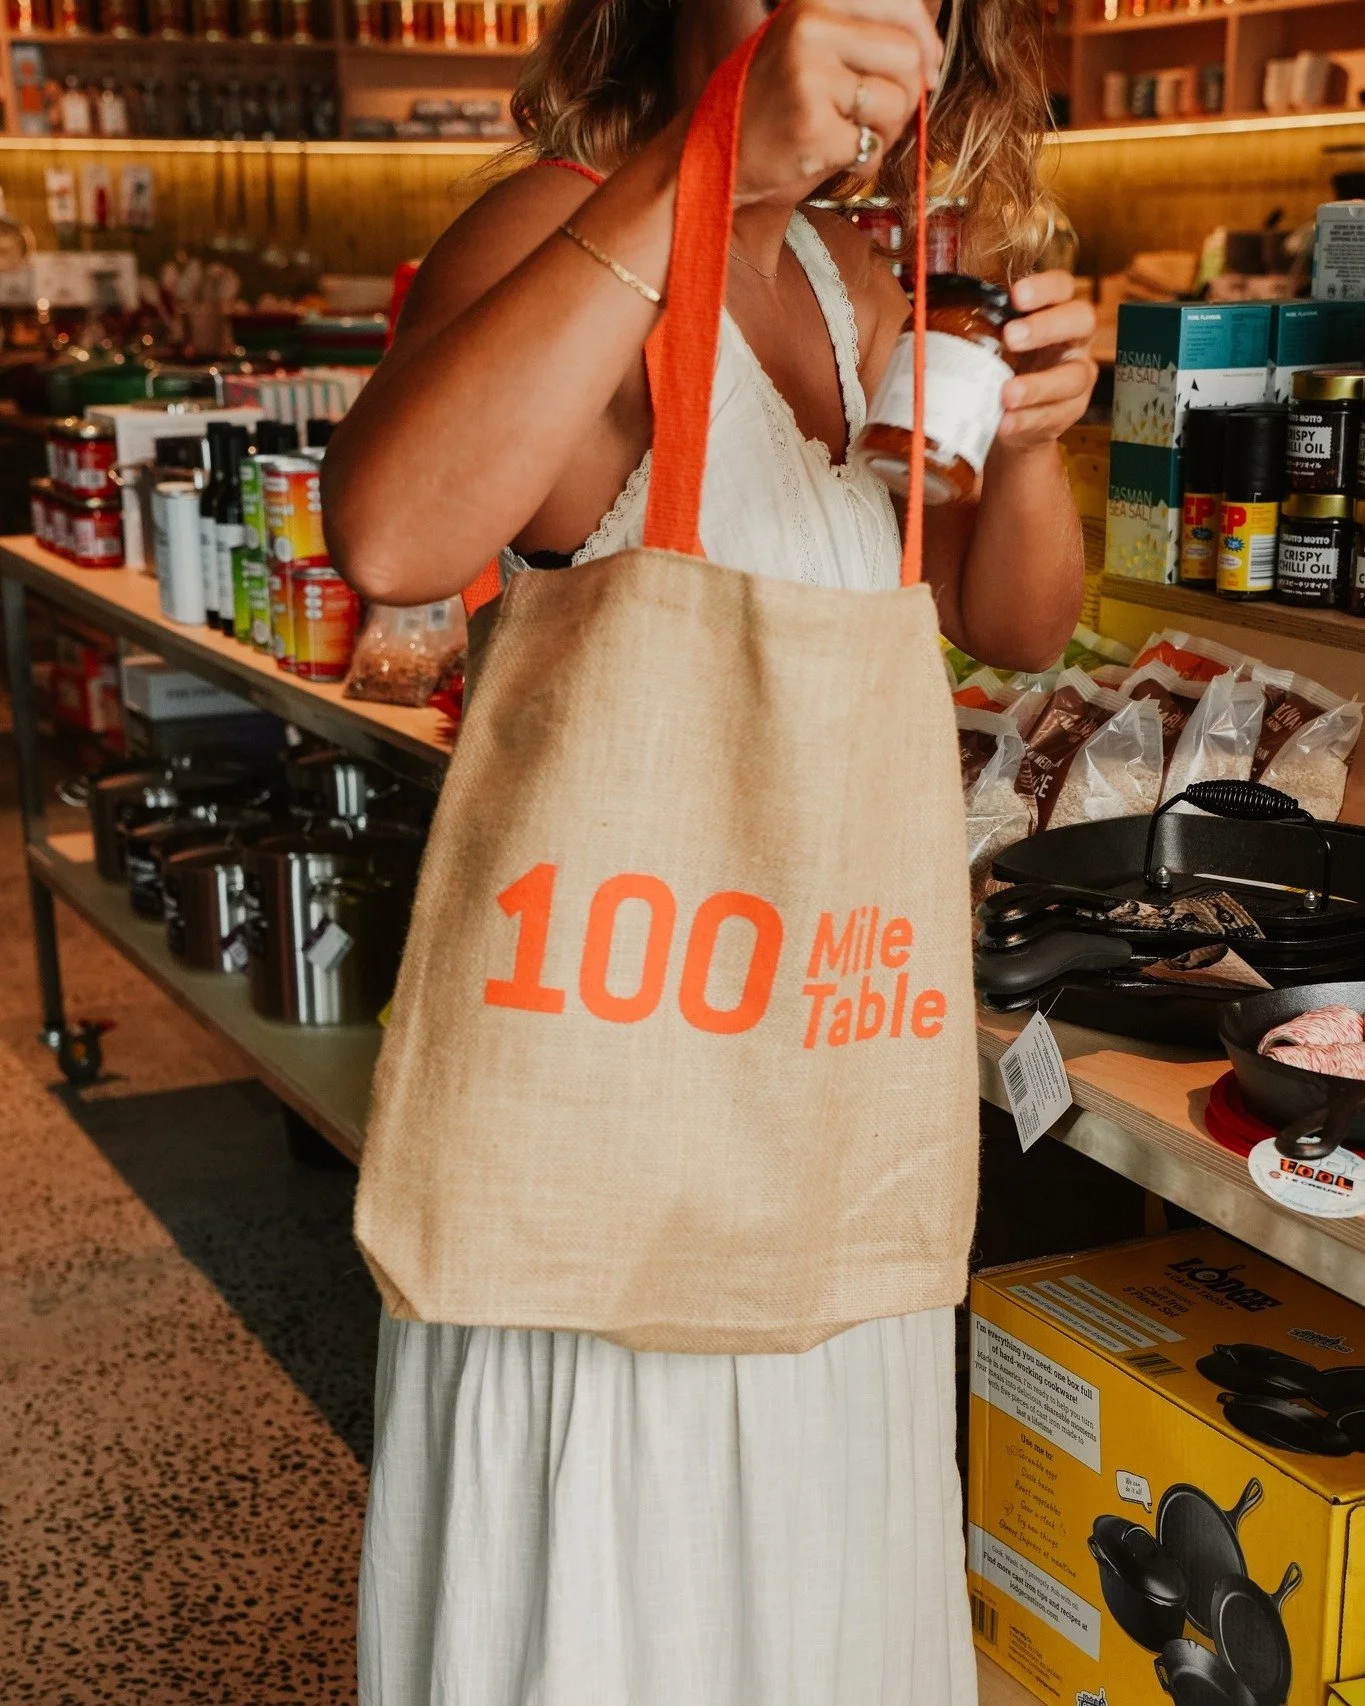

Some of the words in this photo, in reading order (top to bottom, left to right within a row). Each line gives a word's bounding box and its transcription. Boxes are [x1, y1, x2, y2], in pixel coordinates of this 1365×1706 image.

[1117, 350, 1161, 370] TASMAN
[1116, 366, 1134, 382] SEA
[1136, 368, 1160, 386] SALT
[1299, 415, 1323, 423] MOTTO
[1304, 443, 1324, 454] OIL
[1110, 485, 1152, 507] TASMAN
[1110, 502, 1126, 517] SEA
[1128, 504, 1152, 521] SALT
[1304, 536, 1330, 544] MOTTO
[1279, 560, 1305, 573] CHILLI
[1310, 564, 1332, 574] OIL
[1284, 550, 1322, 562] CRISPY
[483, 862, 785, 1036] 100
[806, 906, 914, 980] Mile
[802, 972, 947, 1050] Table
[976, 1320, 986, 1334] I'm
[988, 1329, 1020, 1356] everything
[1022, 1350, 1034, 1363] you
[1036, 1357, 1052, 1374] need:
[1054, 1370, 1066, 1382] one
[1066, 1376, 1080, 1390] box
[1080, 1382, 1092, 1400] full
[992, 1345, 999, 1355] of
[1000, 1348, 1043, 1384] hard-working
[1044, 1378, 1078, 1404] cookware!
[974, 1360, 988, 1373] your
[988, 1368, 1004, 1384] meals
[1005, 1378, 1016, 1391] into
[1017, 1386, 1042, 1408] delicious,
[1044, 1402, 1070, 1424] shareable
[1070, 1421, 1096, 1442] moments
[976, 1350, 992, 1365] Made
[992, 1360, 999, 1368] in
[1024, 1378, 1033, 1390] I'm
[1033, 1385, 1049, 1400] ready
[1049, 1396, 1056, 1405] to
[1056, 1398, 1069, 1414] help
[1070, 1410, 1081, 1421] you
[1081, 1416, 1094, 1429] turn
[988, 1378, 1000, 1392] with
[1000, 1385, 1010, 1398] five
[1012, 1394, 1029, 1410] pieces
[1030, 1402, 1036, 1412] of
[1036, 1407, 1048, 1422] cast
[1048, 1416, 1060, 1430] iron
[1061, 1426, 1077, 1440] made
[1078, 1435, 1084, 1445] to
[1016, 1406, 1026, 1418] last
[1020, 1433, 1033, 1448] Use
[1034, 1443, 1045, 1455] me
[1018, 1448, 1044, 1472] Scramble
[1015, 1480, 1031, 1496] Roast
[1033, 1494, 1061, 1517] vegetables
[1018, 1514, 1026, 1529] Try
[983, 1551, 996, 1566] Find
[996, 1562, 1012, 1576] more
[1012, 1572, 1024, 1586] cast
[1024, 1580, 1036, 1595] iron
[1037, 1588, 1048, 1603] tips
[1048, 1598, 1060, 1612] and
[1060, 1607, 1081, 1628] recipes
[1082, 1622, 1088, 1632] at
[1020, 1562, 1028, 1575] Dry
[1050, 1584, 1060, 1596] Rub
[1060, 1592, 1072, 1606] with
